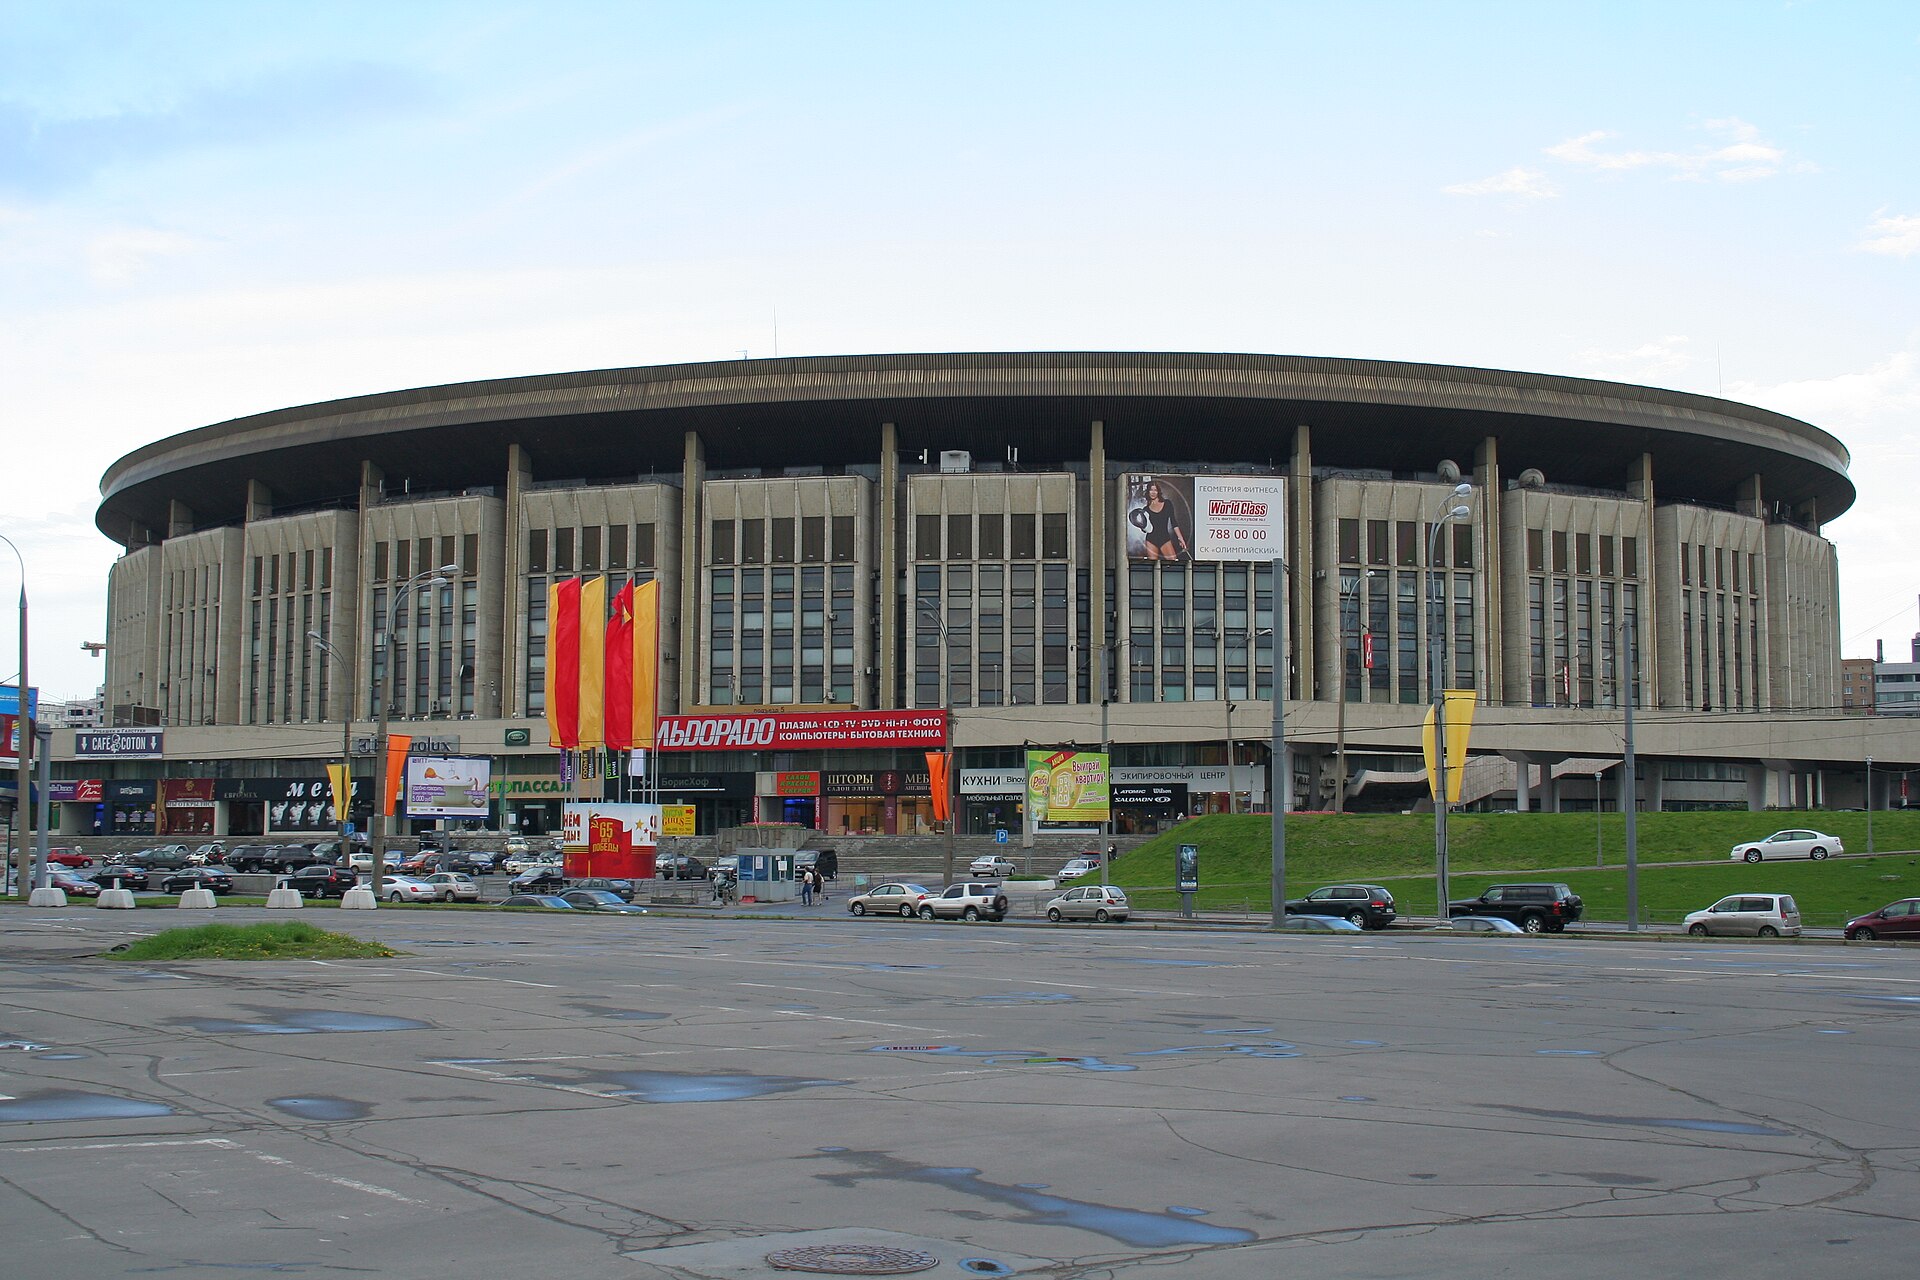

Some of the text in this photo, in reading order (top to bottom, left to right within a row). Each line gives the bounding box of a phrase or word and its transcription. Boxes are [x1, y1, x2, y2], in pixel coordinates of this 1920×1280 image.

[1199, 485, 1279, 494] ГЕОМЕТРИЯ ФИТНЕСА
[1210, 502, 1266, 515] World Class
[1209, 529, 1267, 540] 788 00 00
[1211, 546, 1279, 554] «ОЛИМПИЙСКИЙ»
[779, 718, 941, 730] ПЛАЗМА LCD TV DVD HI-FI ФОТО
[779, 730, 941, 741] КОМПЬЮТЕРЫ БЫТОВАЯ ТЕХНИКА
[92, 736, 146, 751] CAFÉ COTON
[1072, 758, 1100, 773] Выиграй
[828, 774, 874, 784] ШТОРЫ
[905, 774, 930, 784] МЕБ
[962, 776, 1001, 786] КУХНИ
[1075, 771, 1106, 785] квартиру!
[1120, 771, 1194, 780] ЭКИПИРОВОЧНЫЙ
[1200, 771, 1225, 780] ЦЕНТР
[661, 777, 709, 788] БорисХоф
[599, 821, 614, 838] 65
[592, 842, 619, 853] ПОБЕДЫ
